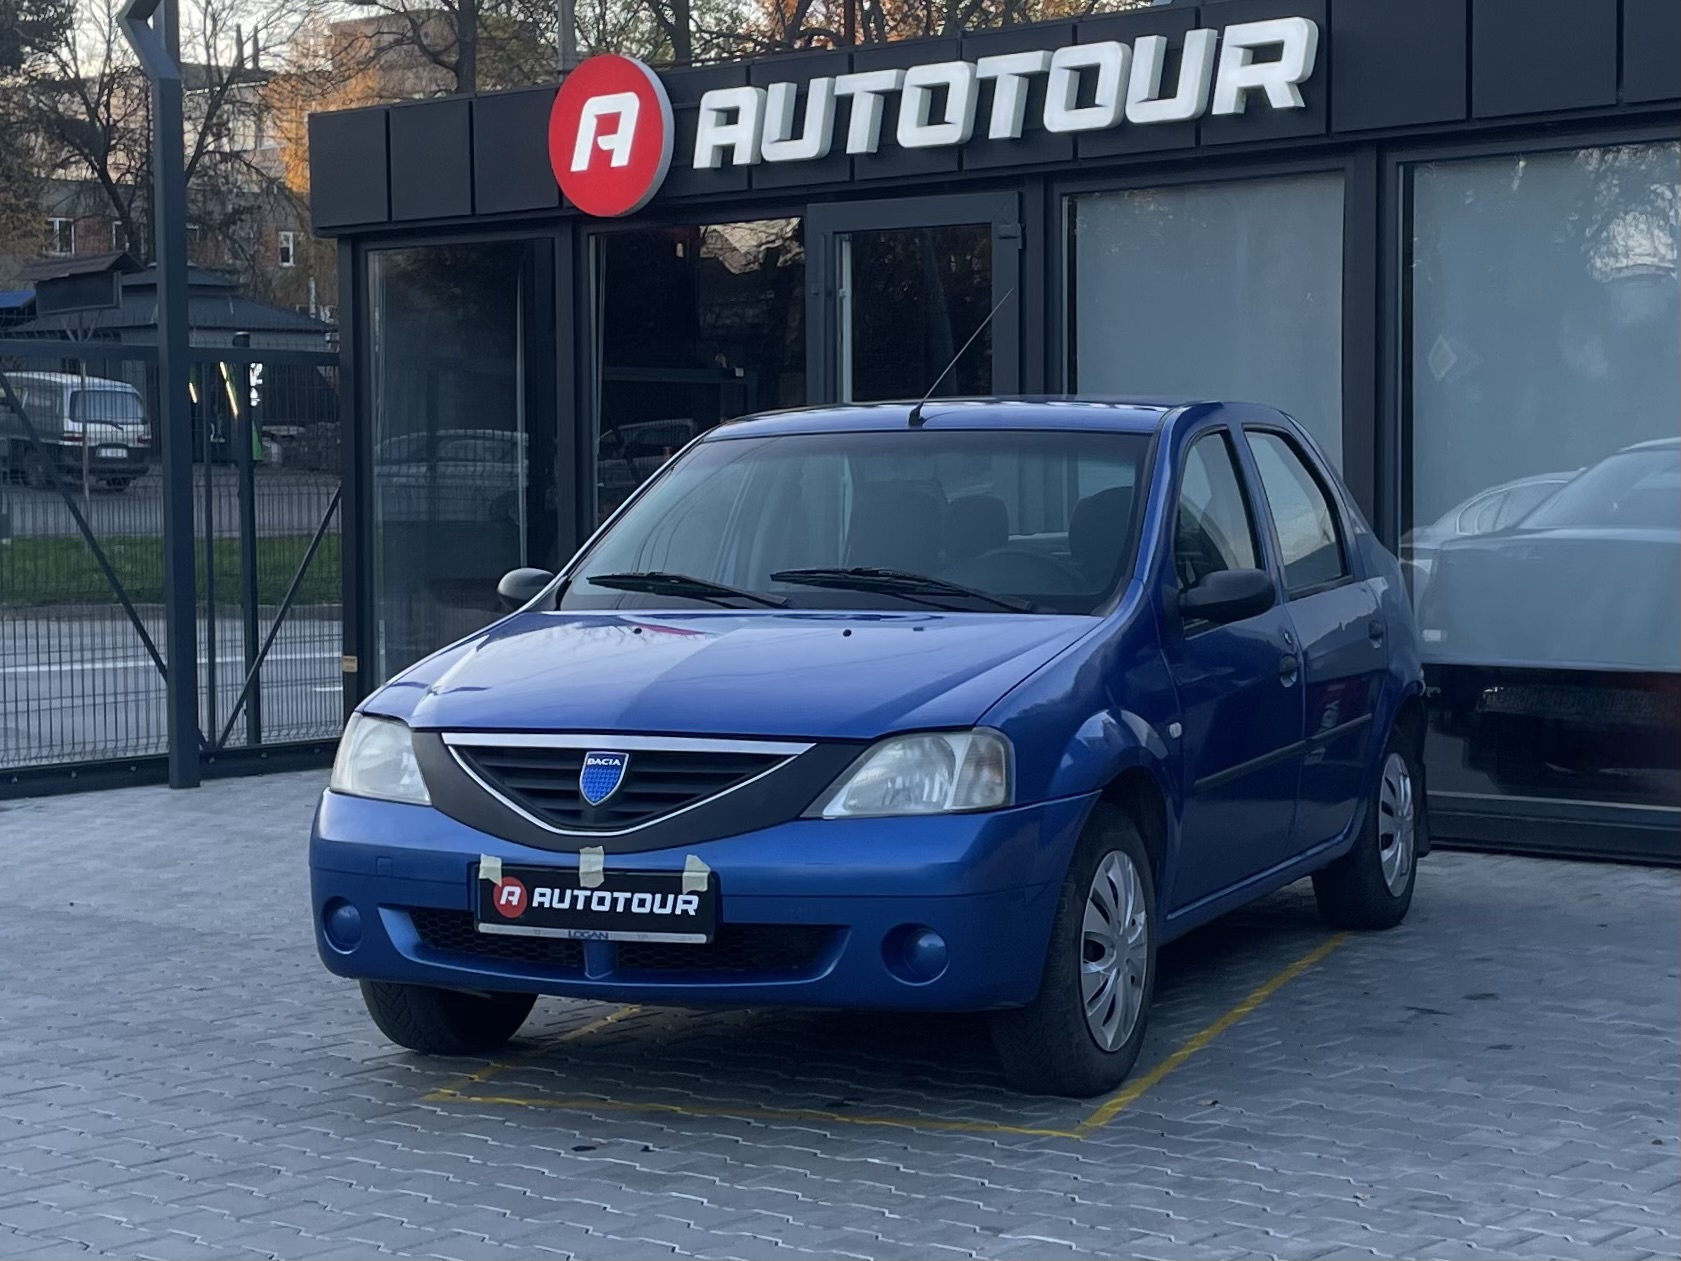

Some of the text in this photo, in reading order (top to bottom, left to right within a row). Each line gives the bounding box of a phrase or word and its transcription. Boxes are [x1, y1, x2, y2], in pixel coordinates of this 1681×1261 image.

[692, 16, 1319, 170] AUTOTOUR
[587, 757, 621, 766] DACIA
[532, 887, 700, 916] AUTOTOUR
[568, 929, 609, 940] LOGAN
